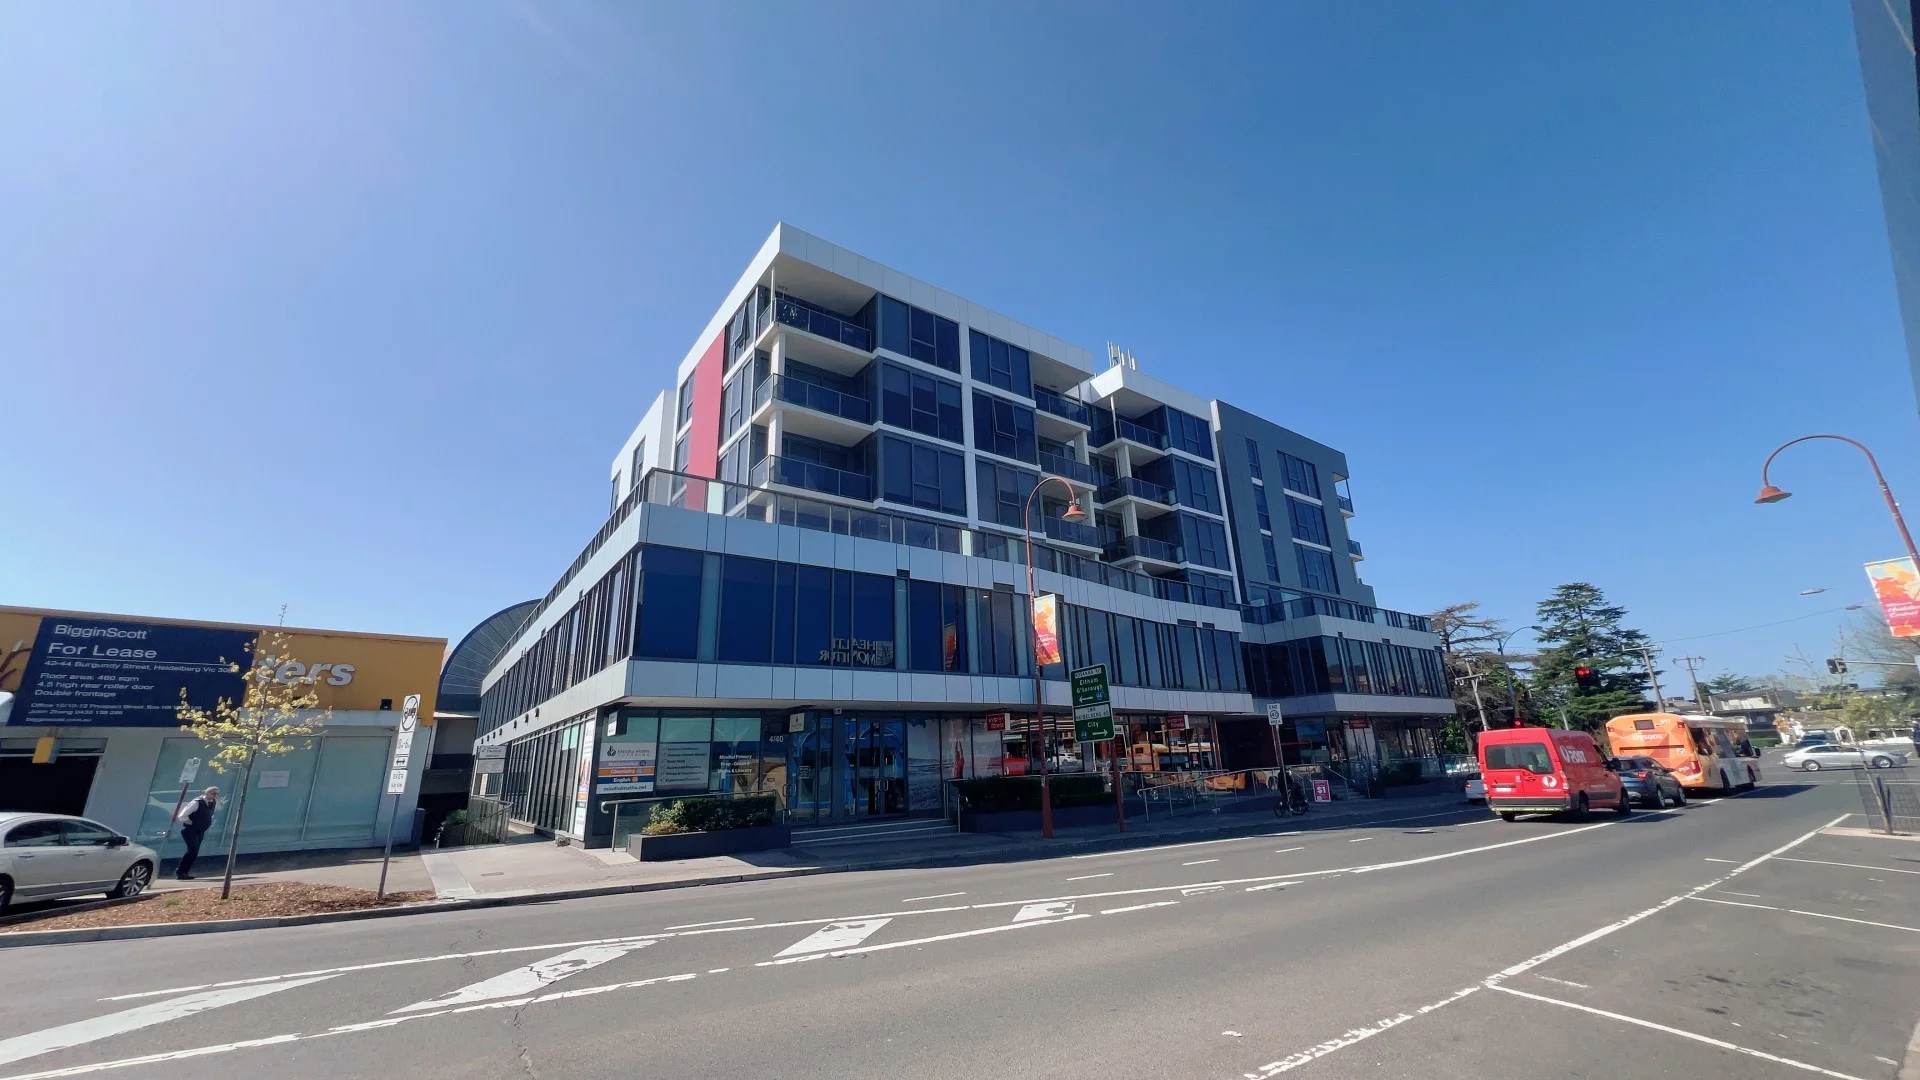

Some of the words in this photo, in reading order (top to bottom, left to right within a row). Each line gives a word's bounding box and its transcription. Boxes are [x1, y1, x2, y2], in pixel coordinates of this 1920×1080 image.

[54, 624, 148, 640] BigginScott
[48, 642, 87, 655] For
[93, 644, 157, 659] Lease
[74, 661, 120, 669] Burgundy
[154, 664, 201, 673] Heidelberg
[251, 654, 356, 687] ters
[1080, 677, 1099, 686] Eltham
[1632, 733, 1663, 742] Dysons
[1567, 749, 1588, 763] POST
